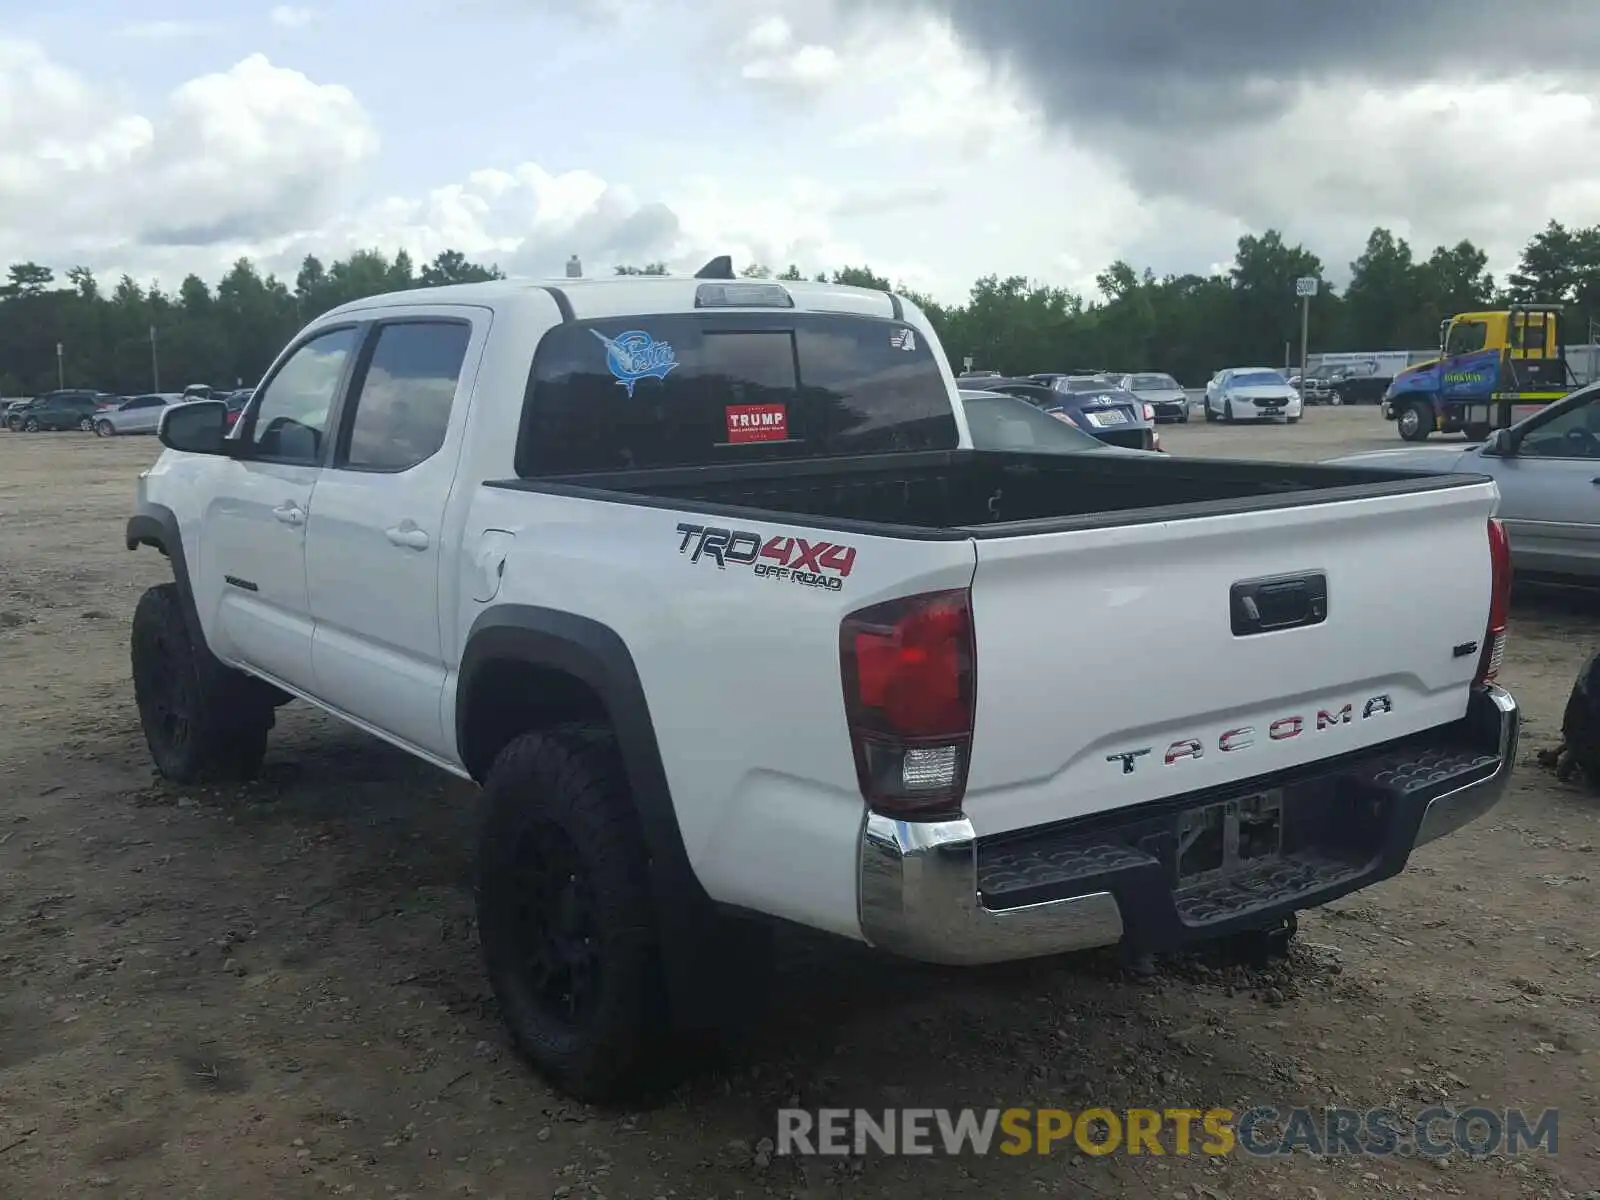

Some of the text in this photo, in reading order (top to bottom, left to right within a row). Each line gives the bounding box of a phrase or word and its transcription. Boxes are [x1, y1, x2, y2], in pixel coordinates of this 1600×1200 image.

[730, 413, 783, 427] TRUMP
[676, 523, 761, 570] TRD
[790, 570, 842, 591] ROAD
[1106, 694, 1393, 774] TACOMA
